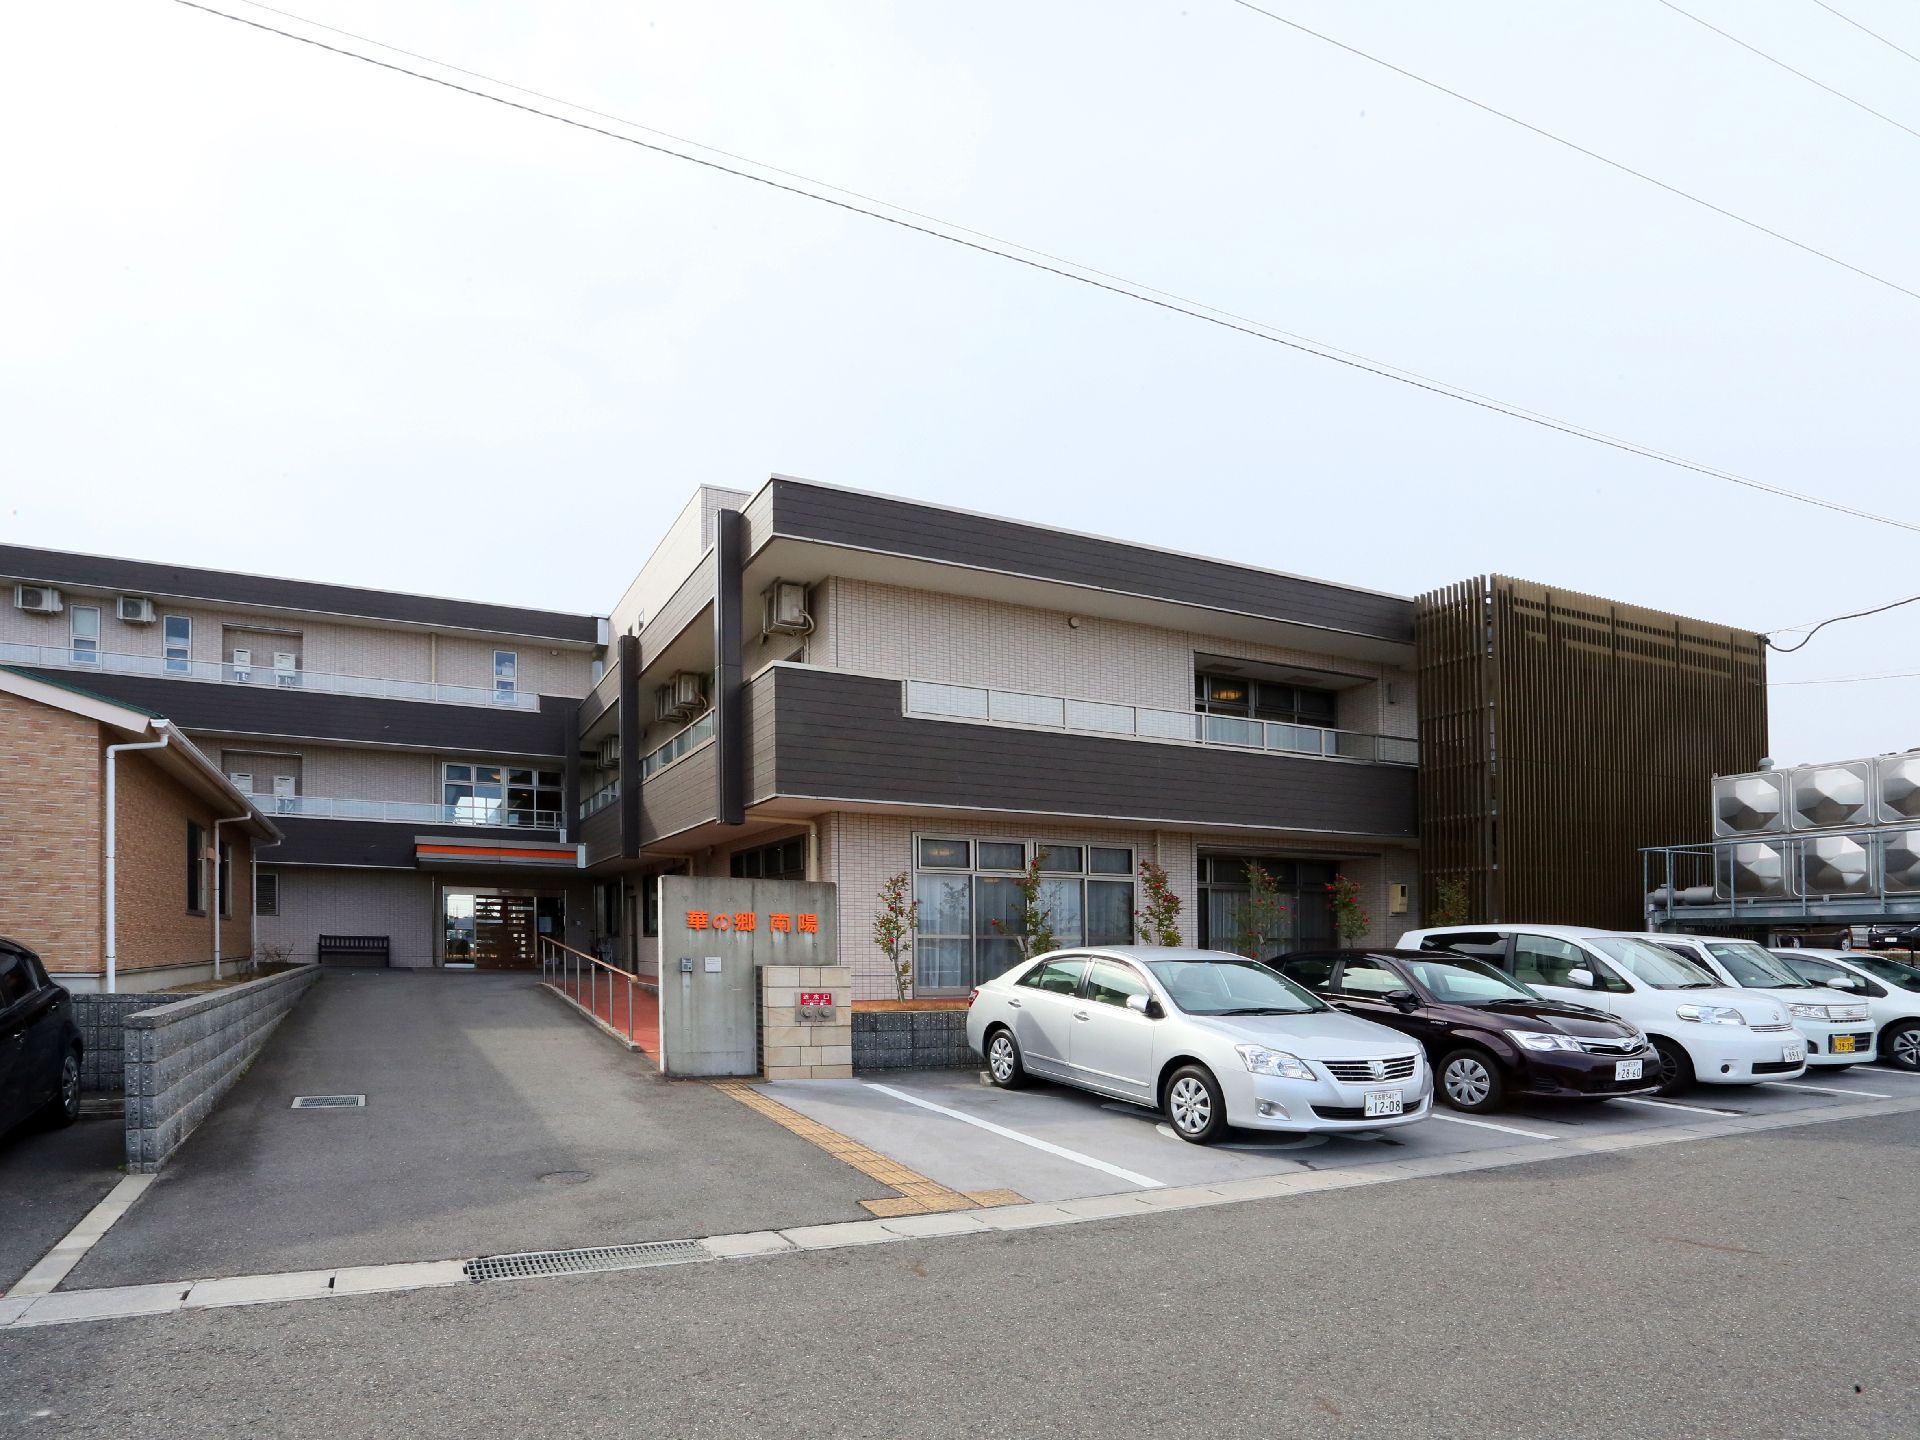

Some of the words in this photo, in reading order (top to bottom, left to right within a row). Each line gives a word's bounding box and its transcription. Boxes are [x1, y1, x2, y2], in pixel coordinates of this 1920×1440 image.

[687, 911, 756, 932] 華の郷
[769, 912, 818, 934] 南陽
